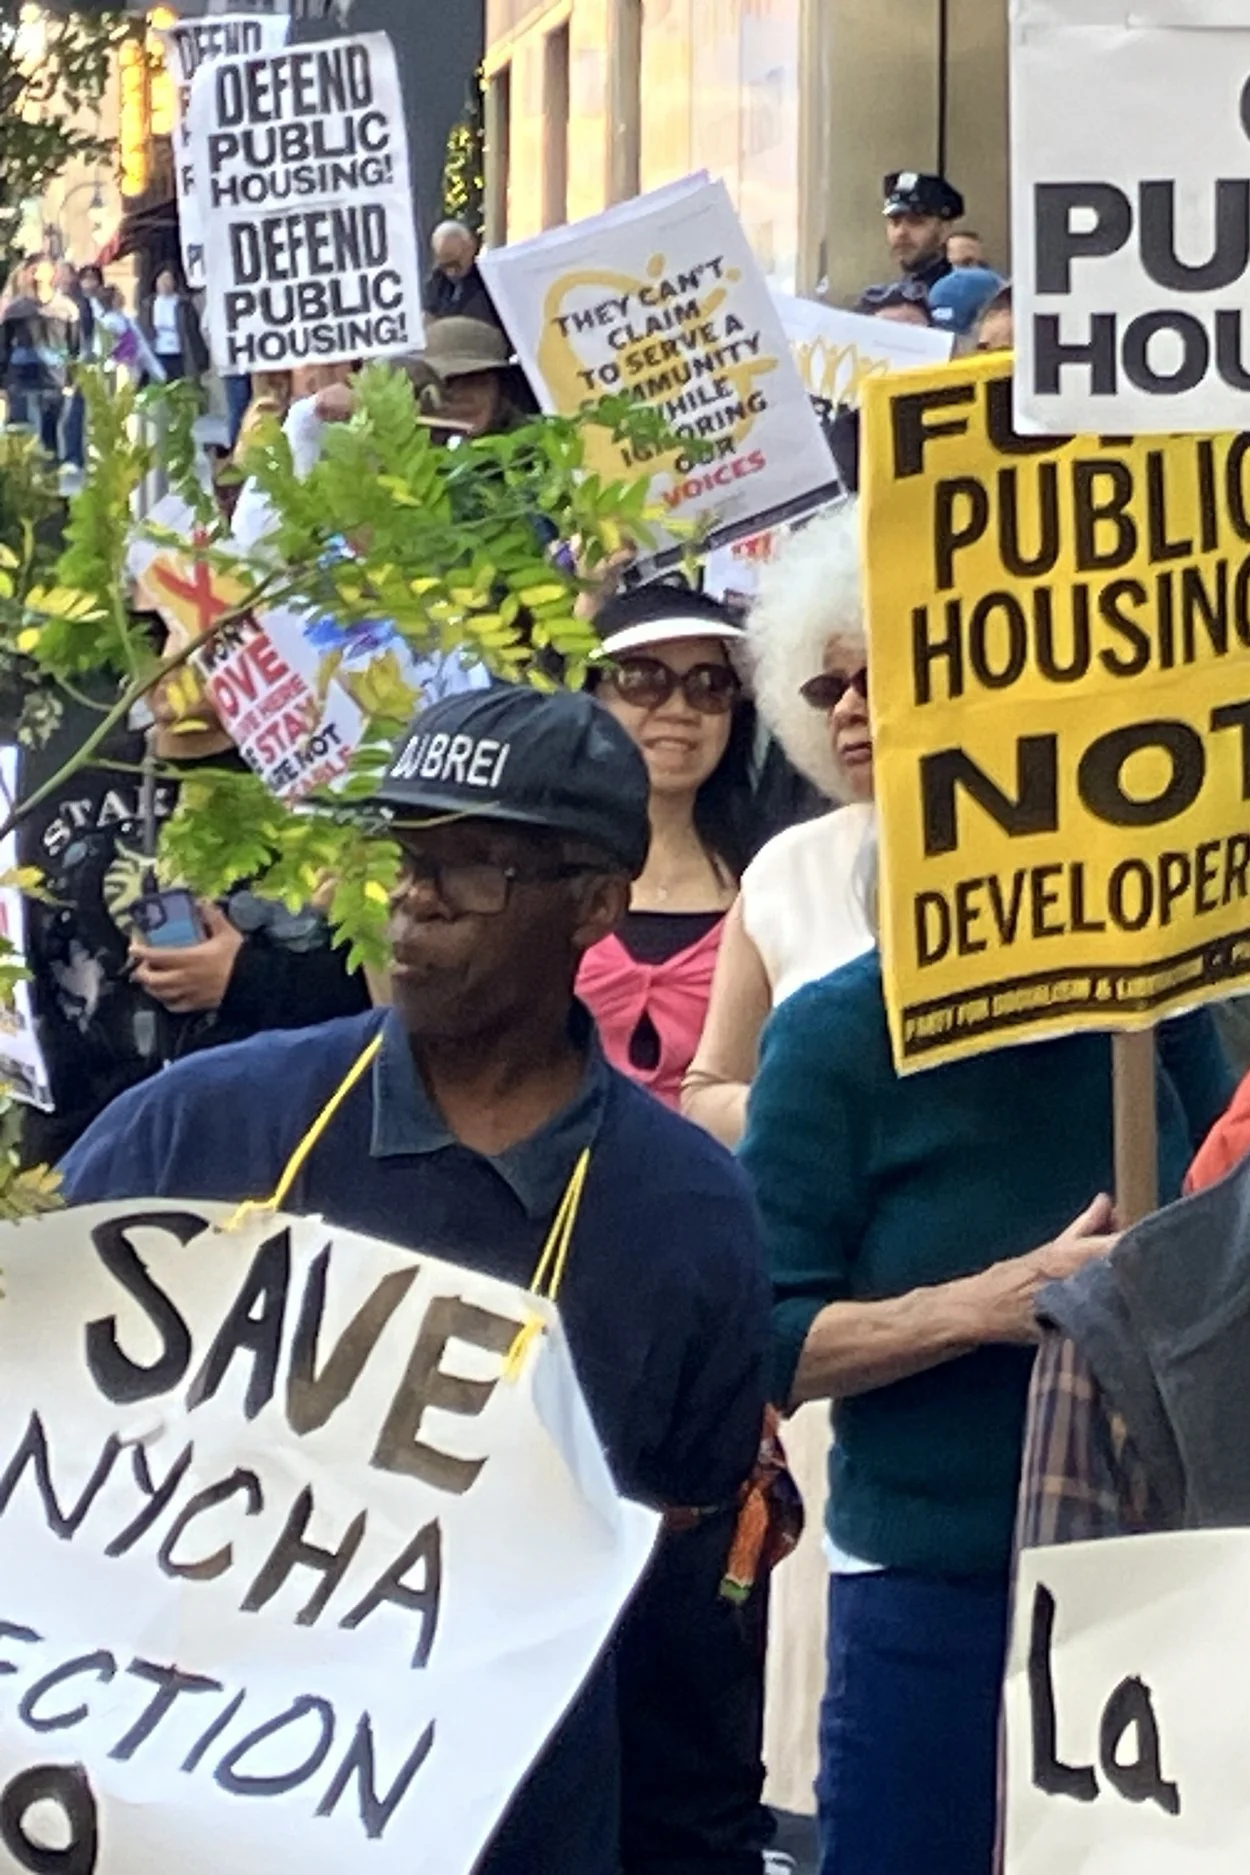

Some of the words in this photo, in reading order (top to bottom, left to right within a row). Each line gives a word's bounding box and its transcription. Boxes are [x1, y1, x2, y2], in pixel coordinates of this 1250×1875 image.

[216, 44, 374, 128] DEFEND
[207, 111, 391, 173] PUBLIC
[211, 154, 394, 208] HOUSING!
[229, 203, 389, 286] DEFEND
[224, 270, 404, 332] PUBLIC
[553, 293, 630, 338] THEY
[638, 256, 724, 306] CAN'T
[608, 298, 702, 351] CLAIM
[227, 312, 408, 365] HOUSING!
[577, 362, 621, 391] TO
[625, 322, 719, 375] SERVE
[725, 313, 745, 336] A
[656, 376, 734, 421] HILE
[661, 449, 767, 507] VOICES
[211, 634, 289, 719] OVE
[85, 1210, 541, 1496] SAVE
[0, 1408, 443, 1670] NYCHA
[1032, 1581, 1181, 1816] La
